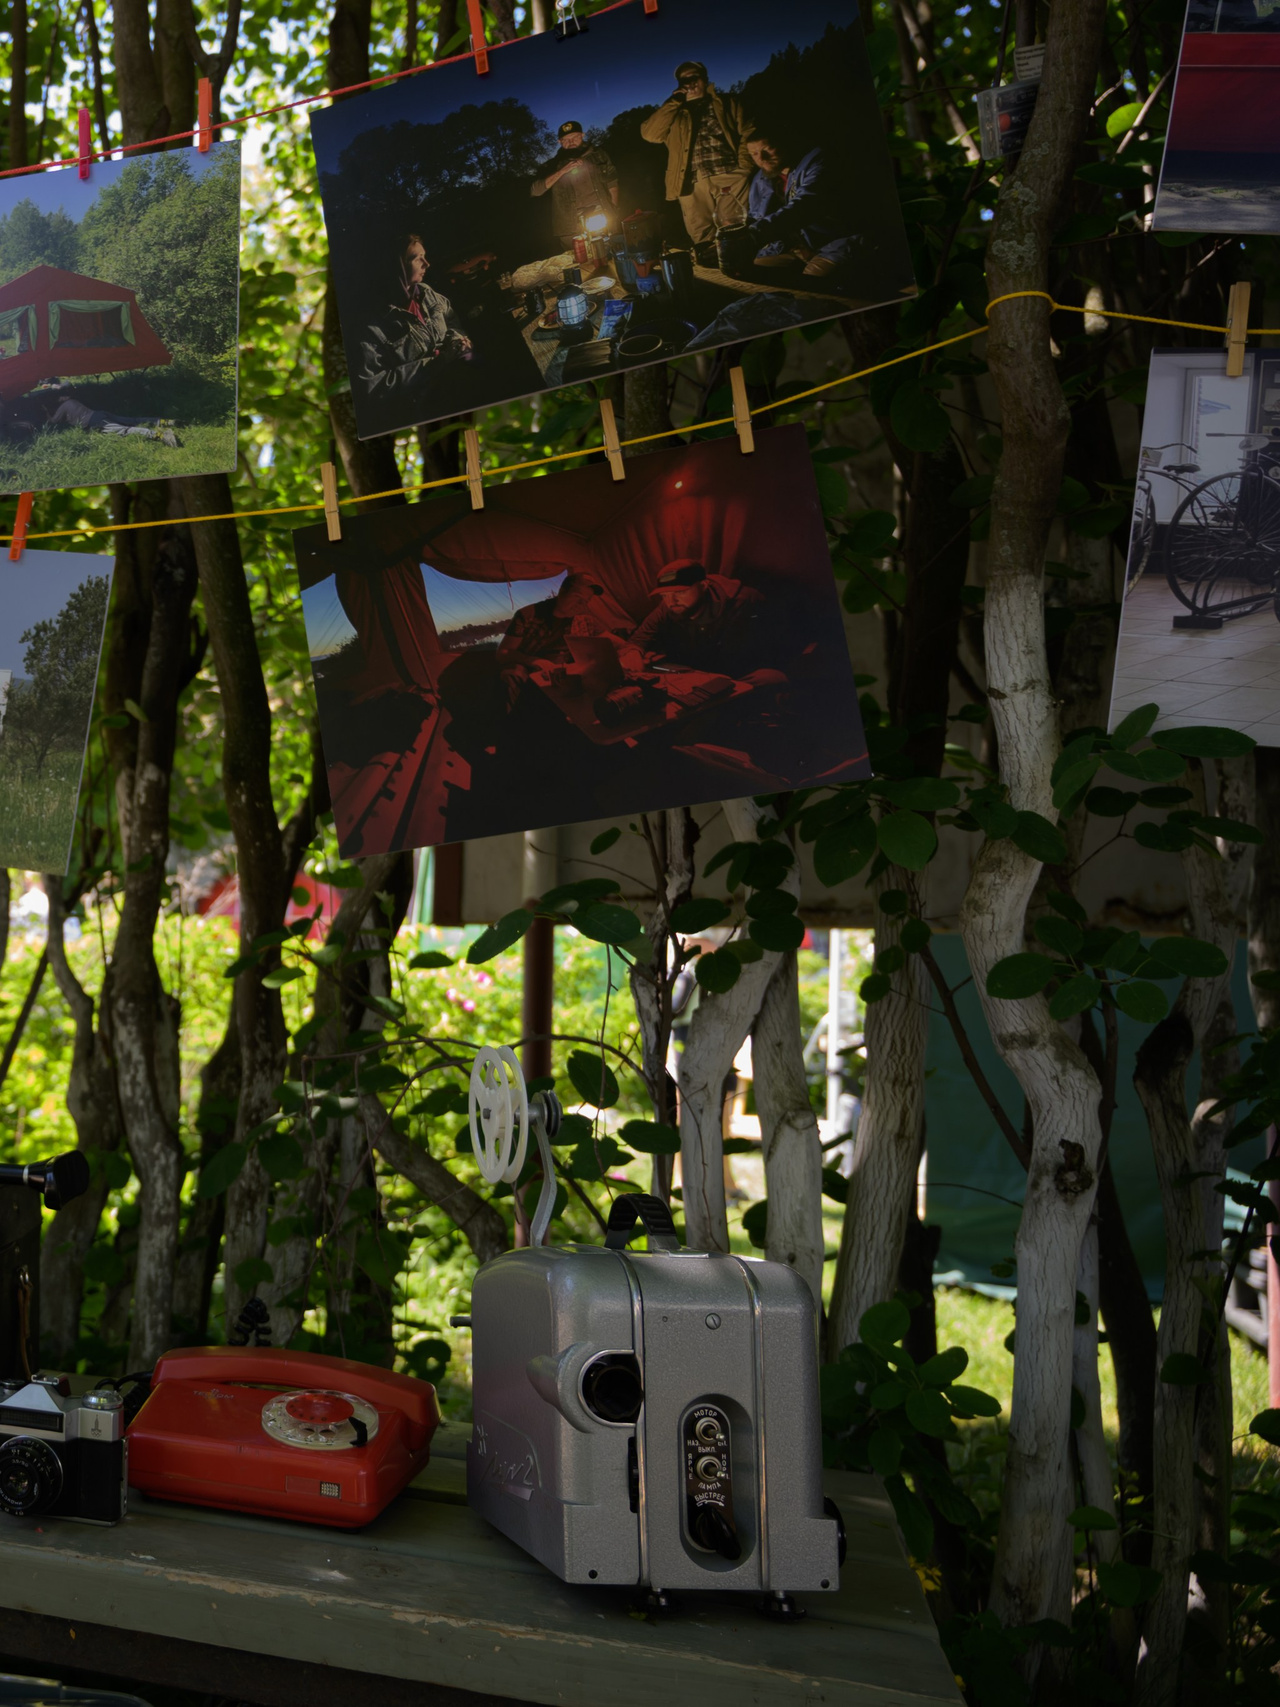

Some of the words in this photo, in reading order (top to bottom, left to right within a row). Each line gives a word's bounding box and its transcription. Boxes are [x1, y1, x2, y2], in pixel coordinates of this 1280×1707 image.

[694, 1409, 718, 1419] МОТОР
[698, 1481, 722, 1491] ЛАМПА
[694, 1491, 726, 1502] БЫСТРЕЕ
